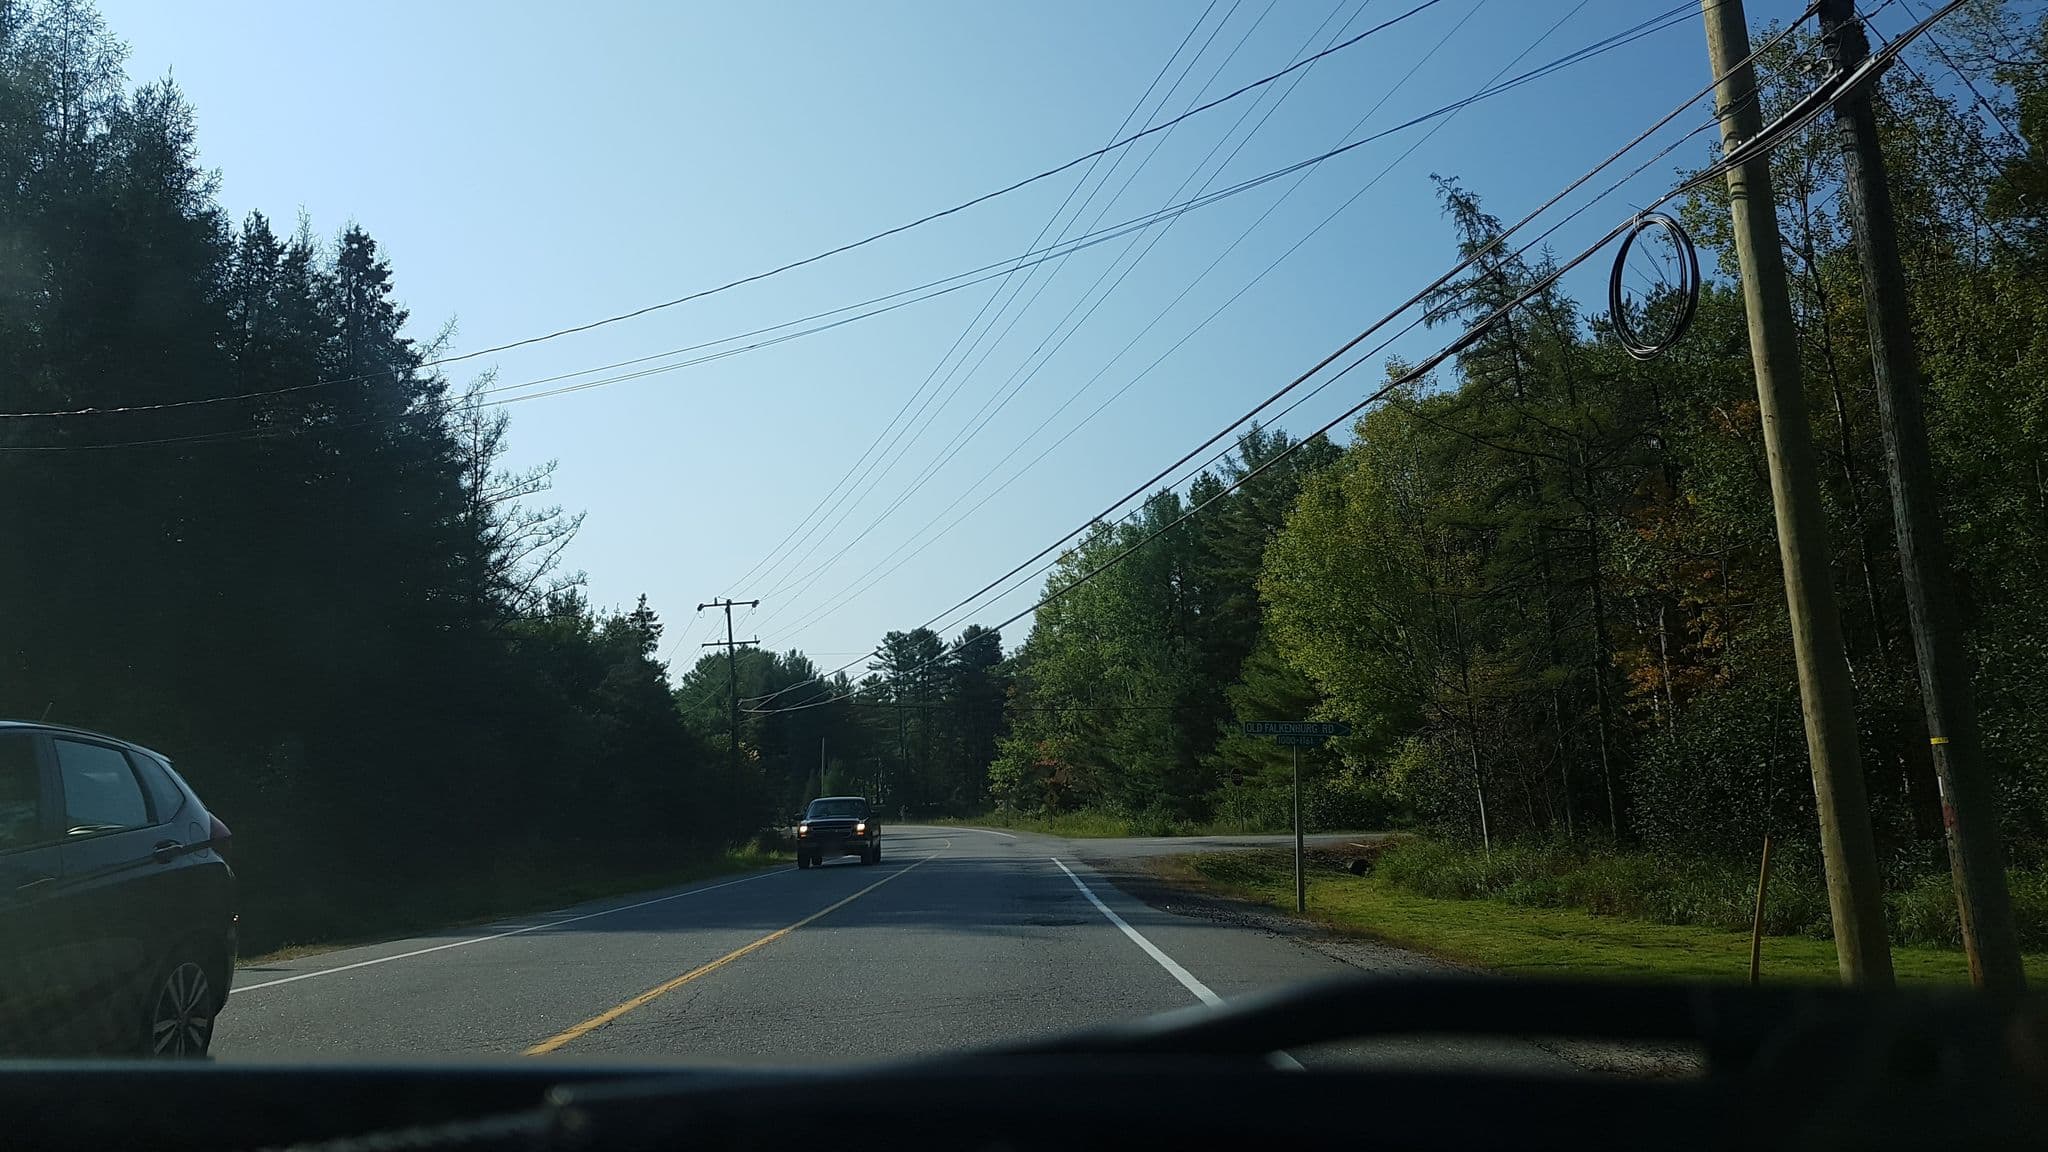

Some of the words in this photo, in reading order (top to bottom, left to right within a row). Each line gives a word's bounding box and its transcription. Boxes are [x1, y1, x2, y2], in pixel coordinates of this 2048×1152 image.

[1246, 723, 1263, 733] OLD
[1264, 723, 1318, 733] FALKENBURG
[1322, 724, 1334, 733] RD
